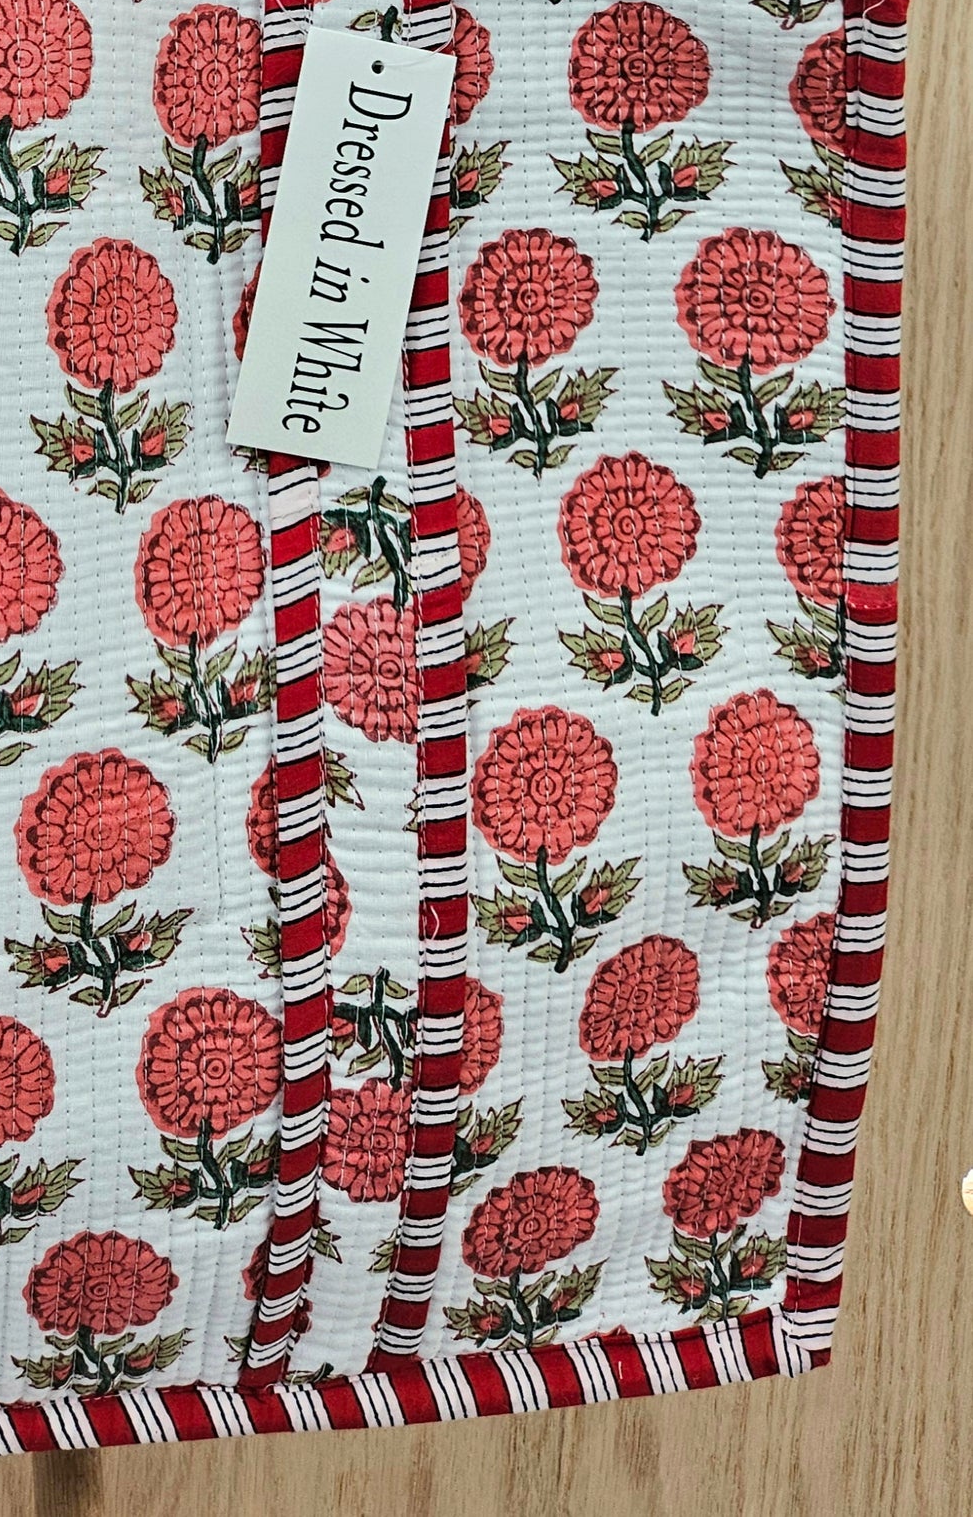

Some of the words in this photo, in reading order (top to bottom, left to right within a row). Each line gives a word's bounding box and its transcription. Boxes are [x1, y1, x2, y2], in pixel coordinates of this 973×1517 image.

[319, 80, 413, 250] Dressed
[309, 256, 370, 303] in
[281, 319, 370, 434] White
